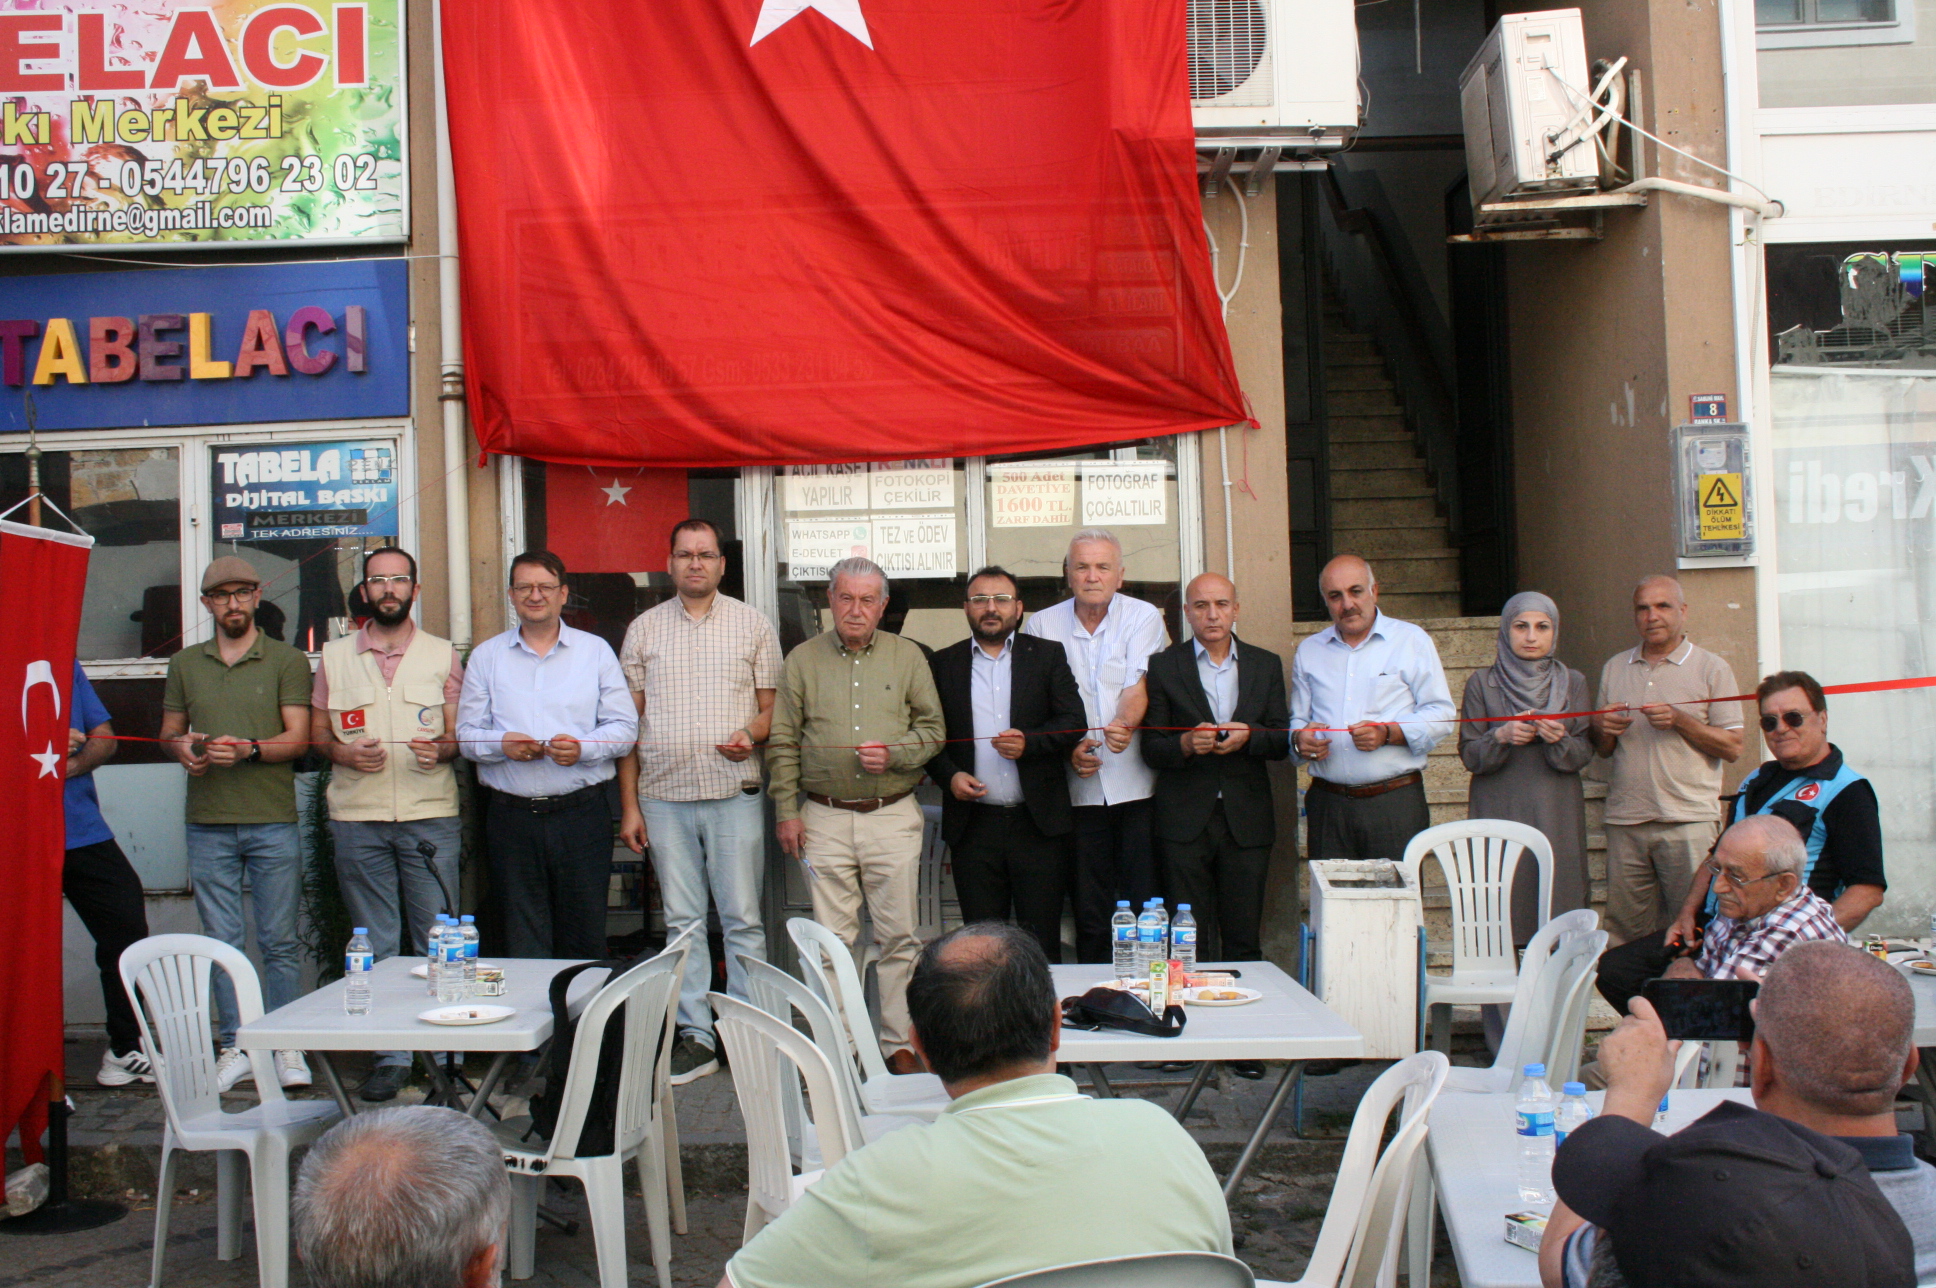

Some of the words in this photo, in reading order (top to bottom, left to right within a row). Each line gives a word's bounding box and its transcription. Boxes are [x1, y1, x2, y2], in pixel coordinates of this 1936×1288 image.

[0, 2, 368, 93] ELACI
[0, 101, 51, 145] kı
[70, 95, 283, 144] Merkezi
[46, 160, 88, 198] 27
[120, 156, 271, 197] 0544796
[280, 155, 325, 192] 23
[333, 153, 378, 191] 02
[0, 305, 367, 386] TABELACI
[1709, 403, 1718, 416] 8
[217, 449, 341, 487] TABELA
[875, 471, 951, 488] FOTOKOPİ
[1002, 472, 1027, 483] 500
[1031, 471, 1066, 482] Adet
[802, 485, 853, 507] YAPILIR
[883, 489, 942, 505] ÇEKİLİR
[996, 482, 1071, 495] DAVETİYE
[226, 489, 310, 510] DİJİTAL
[317, 488, 388, 505] BASKI
[996, 496, 1043, 513] 1600
[1045, 500, 1073, 512] TL.
[1085, 496, 1163, 521] ÇOĞALTILIR
[1706, 508, 1736, 516] DİKKAT!
[252, 511, 359, 527] MERKEZİ
[996, 515, 1031, 525] ZARF
[1032, 513, 1071, 524] DAHİL
[1702, 523, 1741, 531] TEHLİKESİ
[250, 529, 279, 539] TEK
[791, 529, 851, 540] WHATSAPP
[879, 526, 901, 545] TEZ
[903, 530, 915, 544] VE
[917, 521, 949, 544] ÖDEV
[791, 548, 844, 559] E-DEVLET
[916, 551, 954, 571] ALINIR
